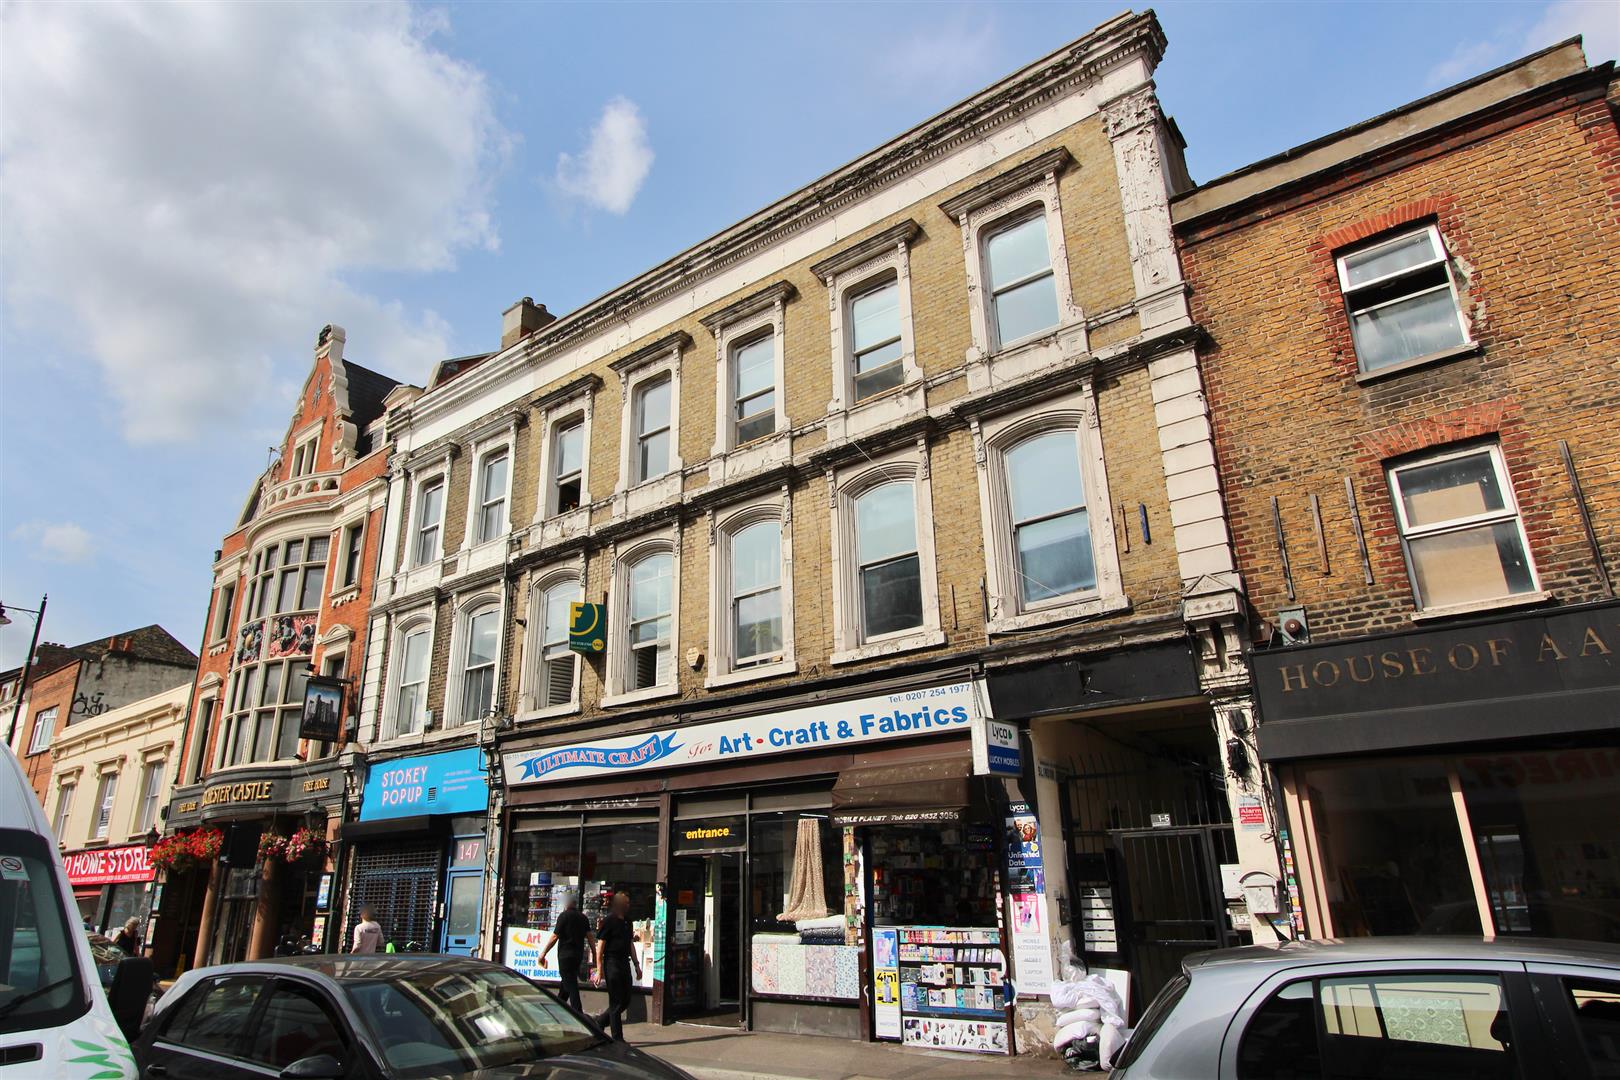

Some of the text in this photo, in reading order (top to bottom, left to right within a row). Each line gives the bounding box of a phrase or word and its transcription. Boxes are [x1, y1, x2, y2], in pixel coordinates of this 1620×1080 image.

[1278, 626, 1620, 692] HOUSE OF AA
[888, 683, 971, 705] Tel: 0207 254 1977
[719, 732, 753, 754] Art
[768, 720, 831, 747] Craft
[837, 720, 854, 739] &
[860, 706, 969, 736] Fabrics
[991, 723, 1008, 740] Lyca
[536, 738, 657, 774] ULTIMATE CRAFT
[381, 765, 429, 789] STOKEY
[232, 781, 273, 801] CASTLE
[381, 786, 423, 806] POPUP
[1009, 804, 1026, 813] Lyca
[858, 815, 887, 823] PLANET
[686, 827, 730, 839] entrance
[460, 843, 480, 860] 147
[72, 853, 105, 875] HOME
[107, 847, 153, 873] STORE
[526, 932, 541, 944] Art
[513, 958, 537, 967] PAINTS
[514, 949, 539, 958] CANVAS
